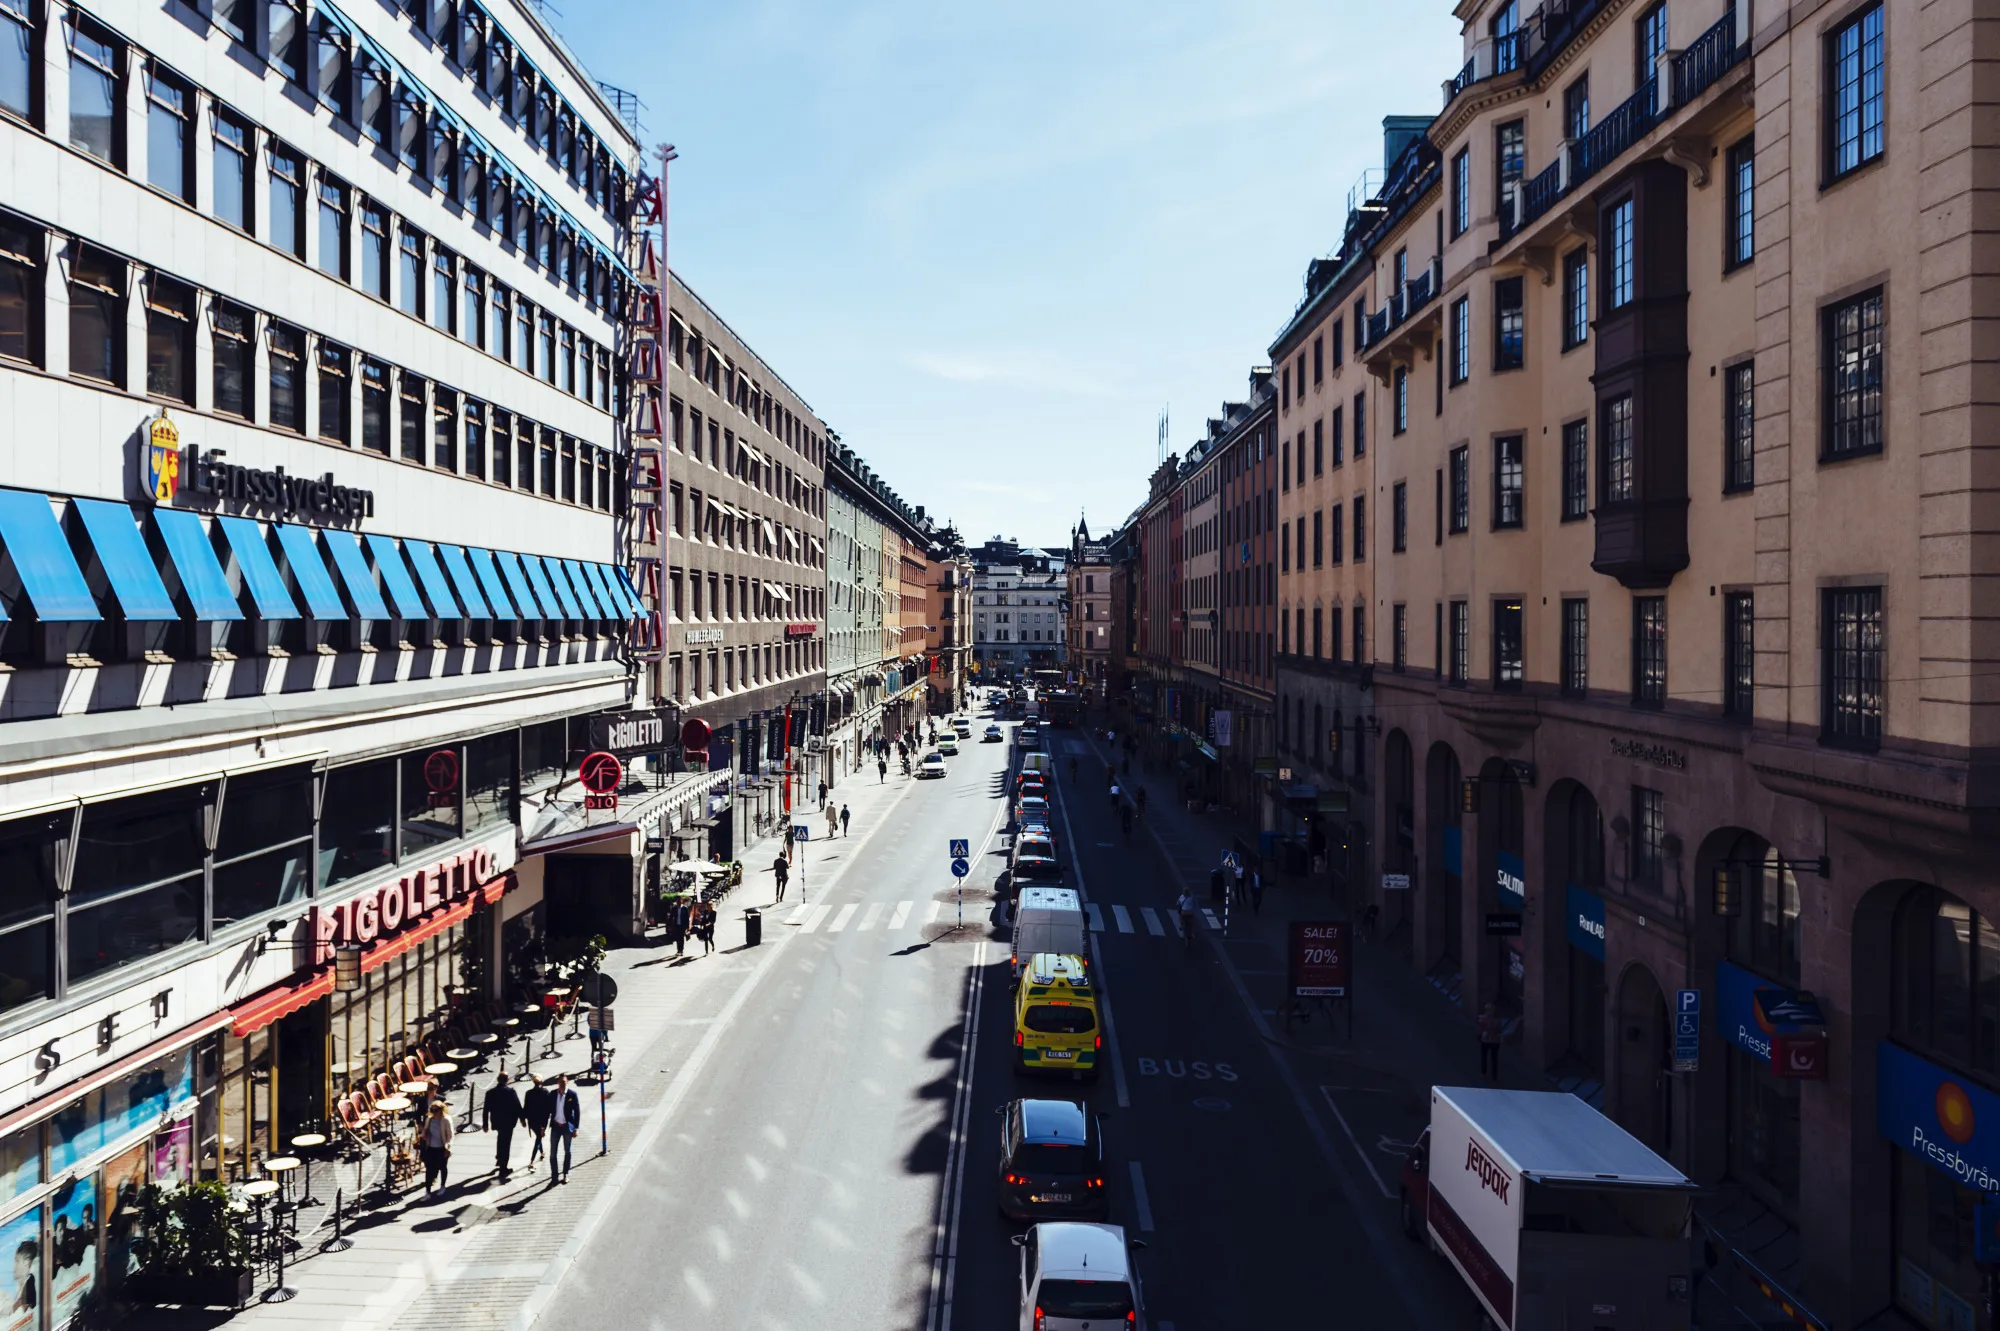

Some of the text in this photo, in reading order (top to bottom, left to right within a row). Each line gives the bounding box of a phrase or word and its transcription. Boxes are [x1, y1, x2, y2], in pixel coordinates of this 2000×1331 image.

[187, 443, 374, 518] Länsstyrelsen
[608, 718, 662, 750] RIGOLETTO
[587, 796, 614, 808] BIO
[313, 846, 491, 965] RIGOLETTO
[1303, 927, 1337, 938] SALE!
[1579, 914, 1605, 939] RunLAB
[1304, 949, 1338, 964] 70%
[1682, 992, 1696, 1011] P
[1137, 1057, 1239, 1082] BUSS
[1465, 1140, 1511, 1206] jetpak
[1911, 1126, 1999, 1196] Pressbyrån
